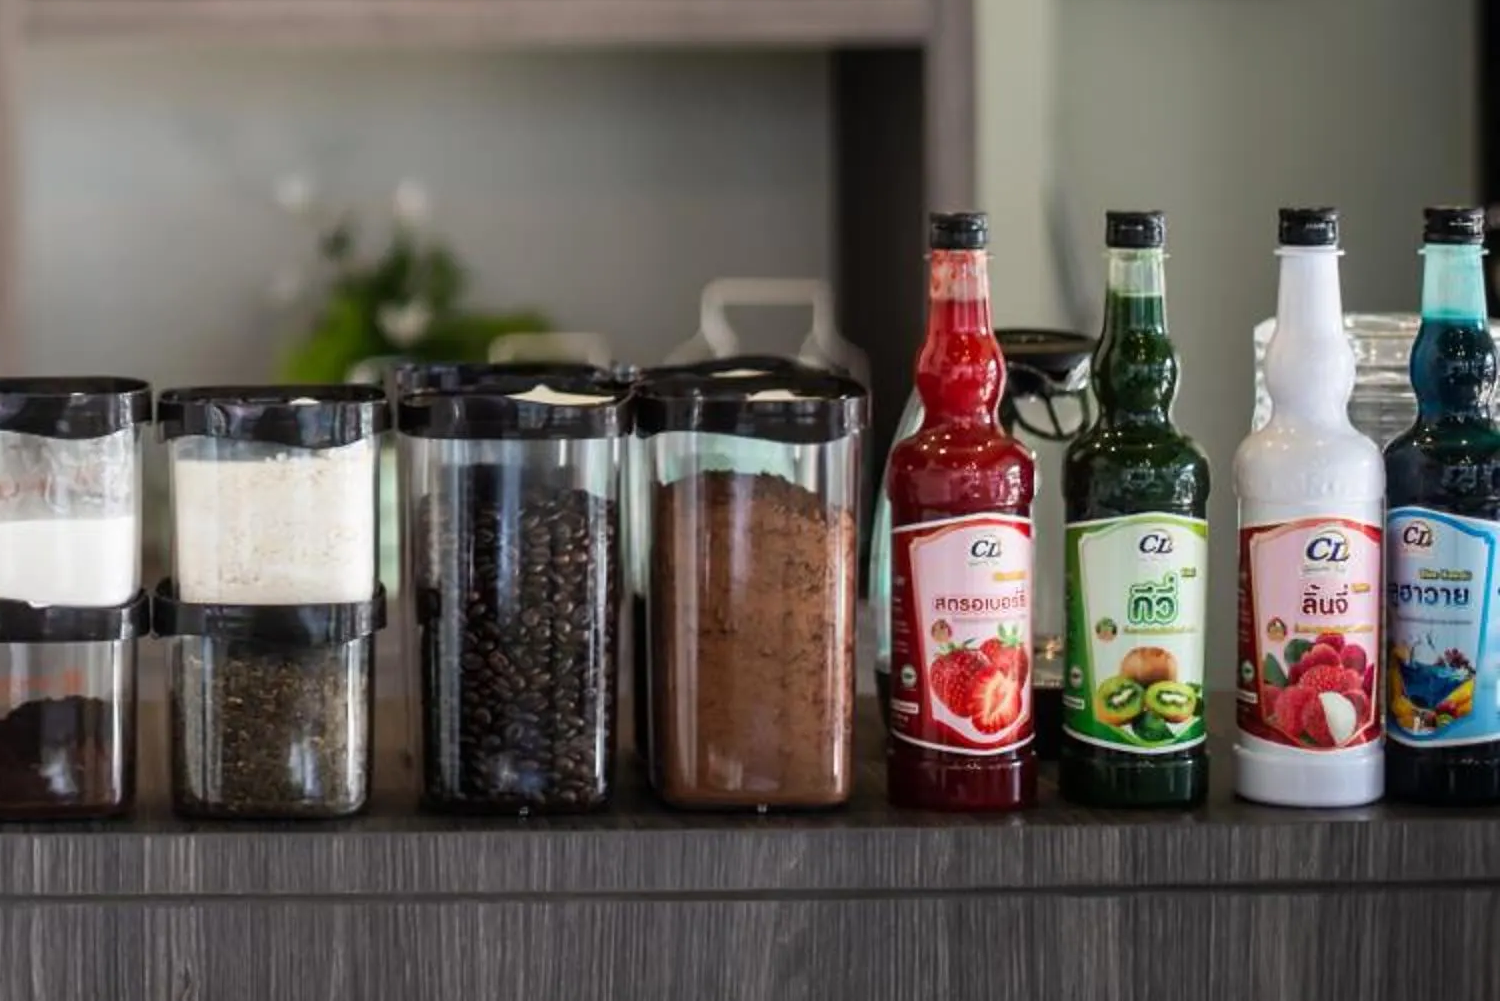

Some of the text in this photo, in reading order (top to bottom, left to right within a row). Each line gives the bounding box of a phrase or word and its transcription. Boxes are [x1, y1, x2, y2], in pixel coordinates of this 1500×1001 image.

[1138, 534, 1173, 554] CL
[1403, 526, 1433, 547] CL
[970, 540, 1002, 558] CL
[1305, 537, 1350, 563] CL
[1131, 574, 1177, 621] กีวี่
[1302, 584, 1349, 614] ลิ้นจี่
